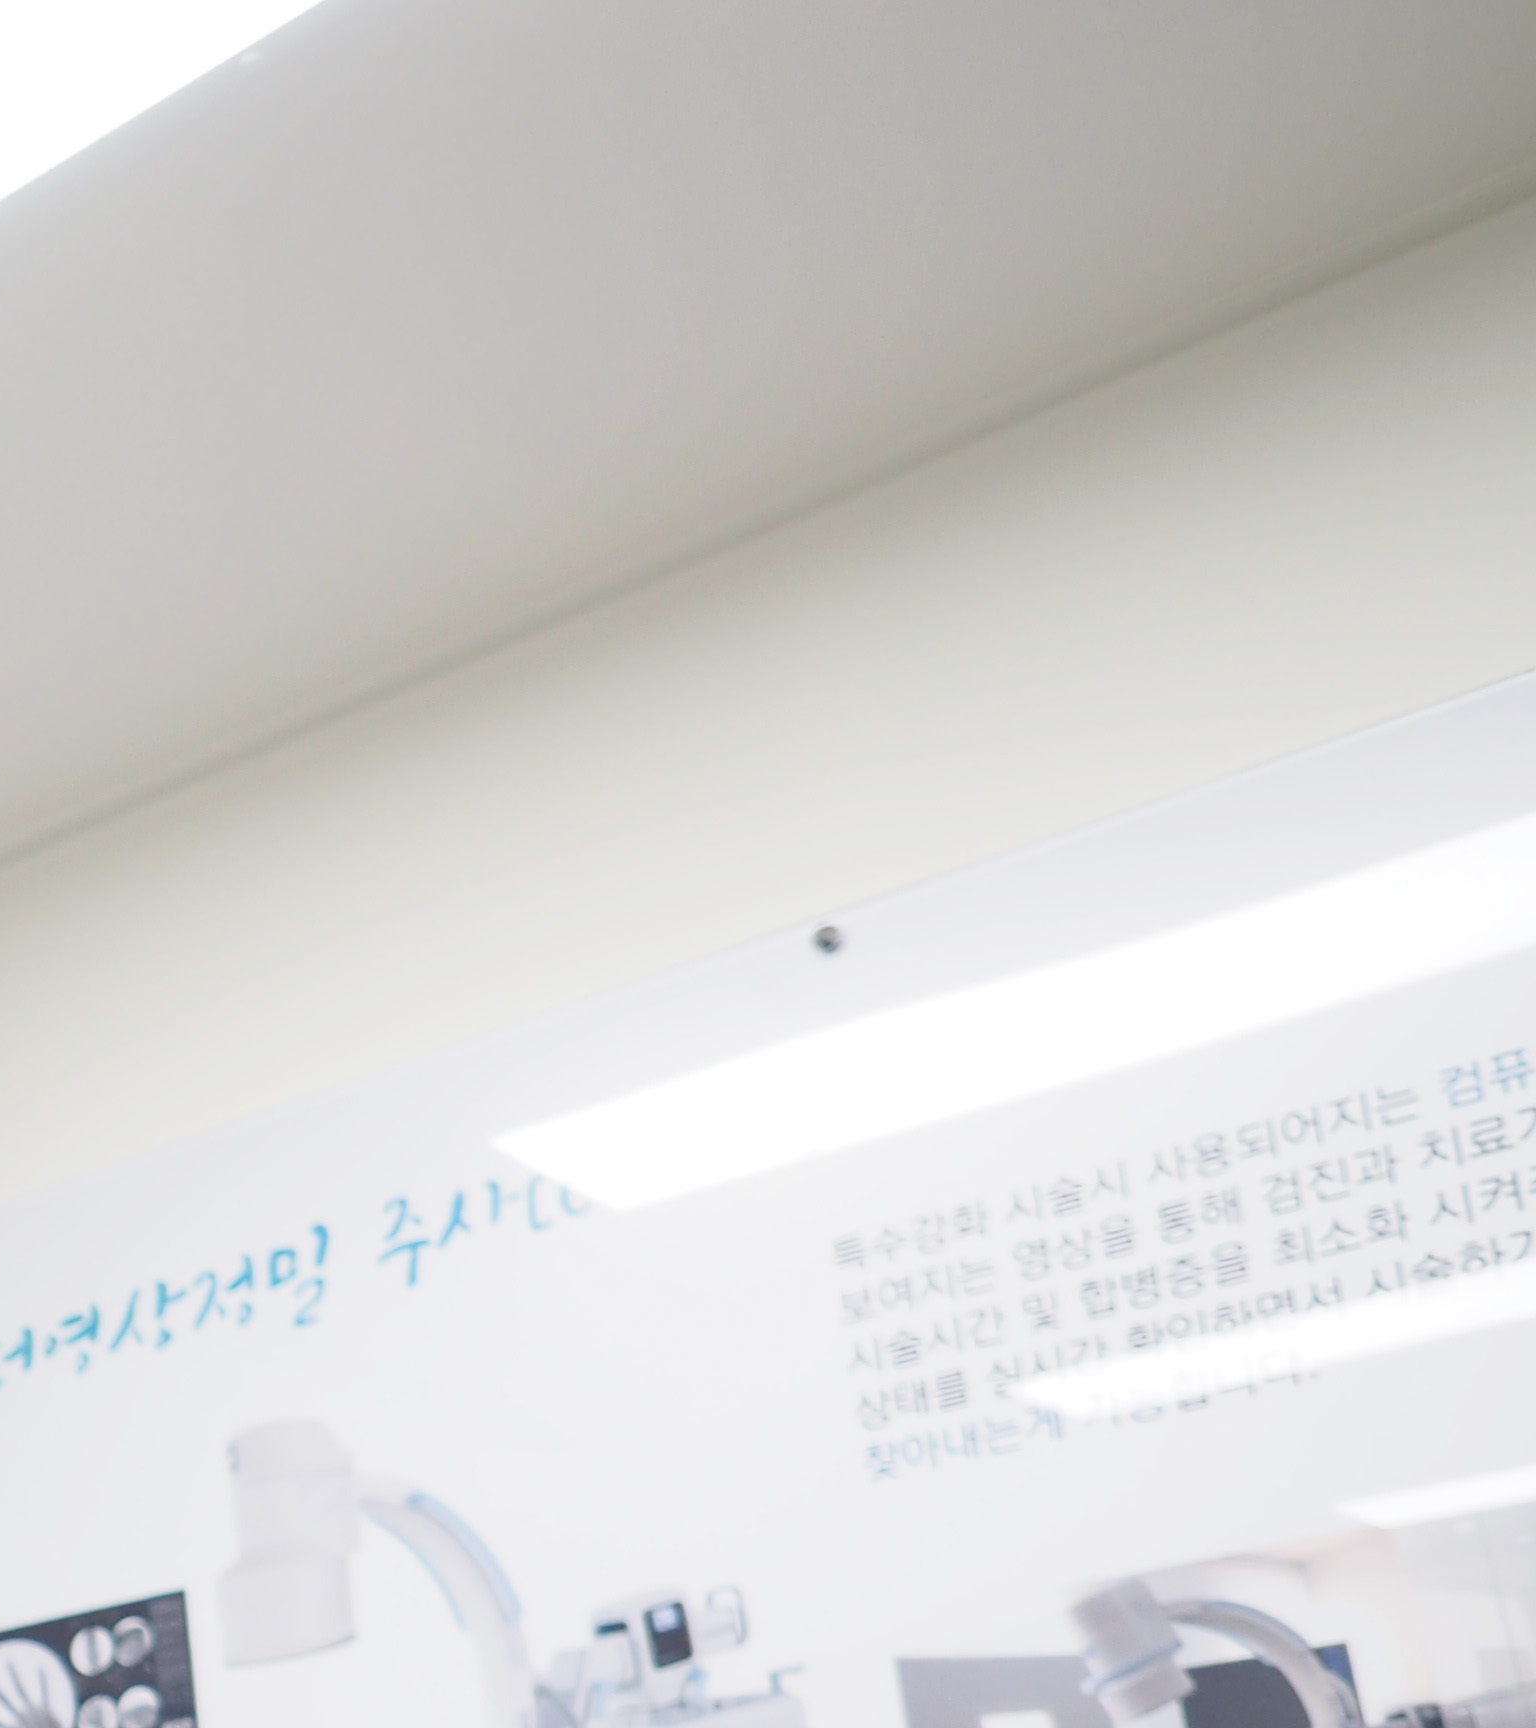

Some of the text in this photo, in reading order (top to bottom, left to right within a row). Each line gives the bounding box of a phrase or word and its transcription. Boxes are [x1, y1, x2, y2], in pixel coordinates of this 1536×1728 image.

[1006, 1159, 1131, 1223] 시술시
[1147, 1085, 1421, 1182] 사용되어지는
[1013, 1213, 1138, 1283] 영상을
[1157, 1185, 1246, 1246] 통해
[1261, 1143, 1402, 1216] 검진과
[849, 1163, 1535, 1373] 시술시간 및 합병증을 최소화 시켜
[856, 1368, 969, 1432] 상태를
